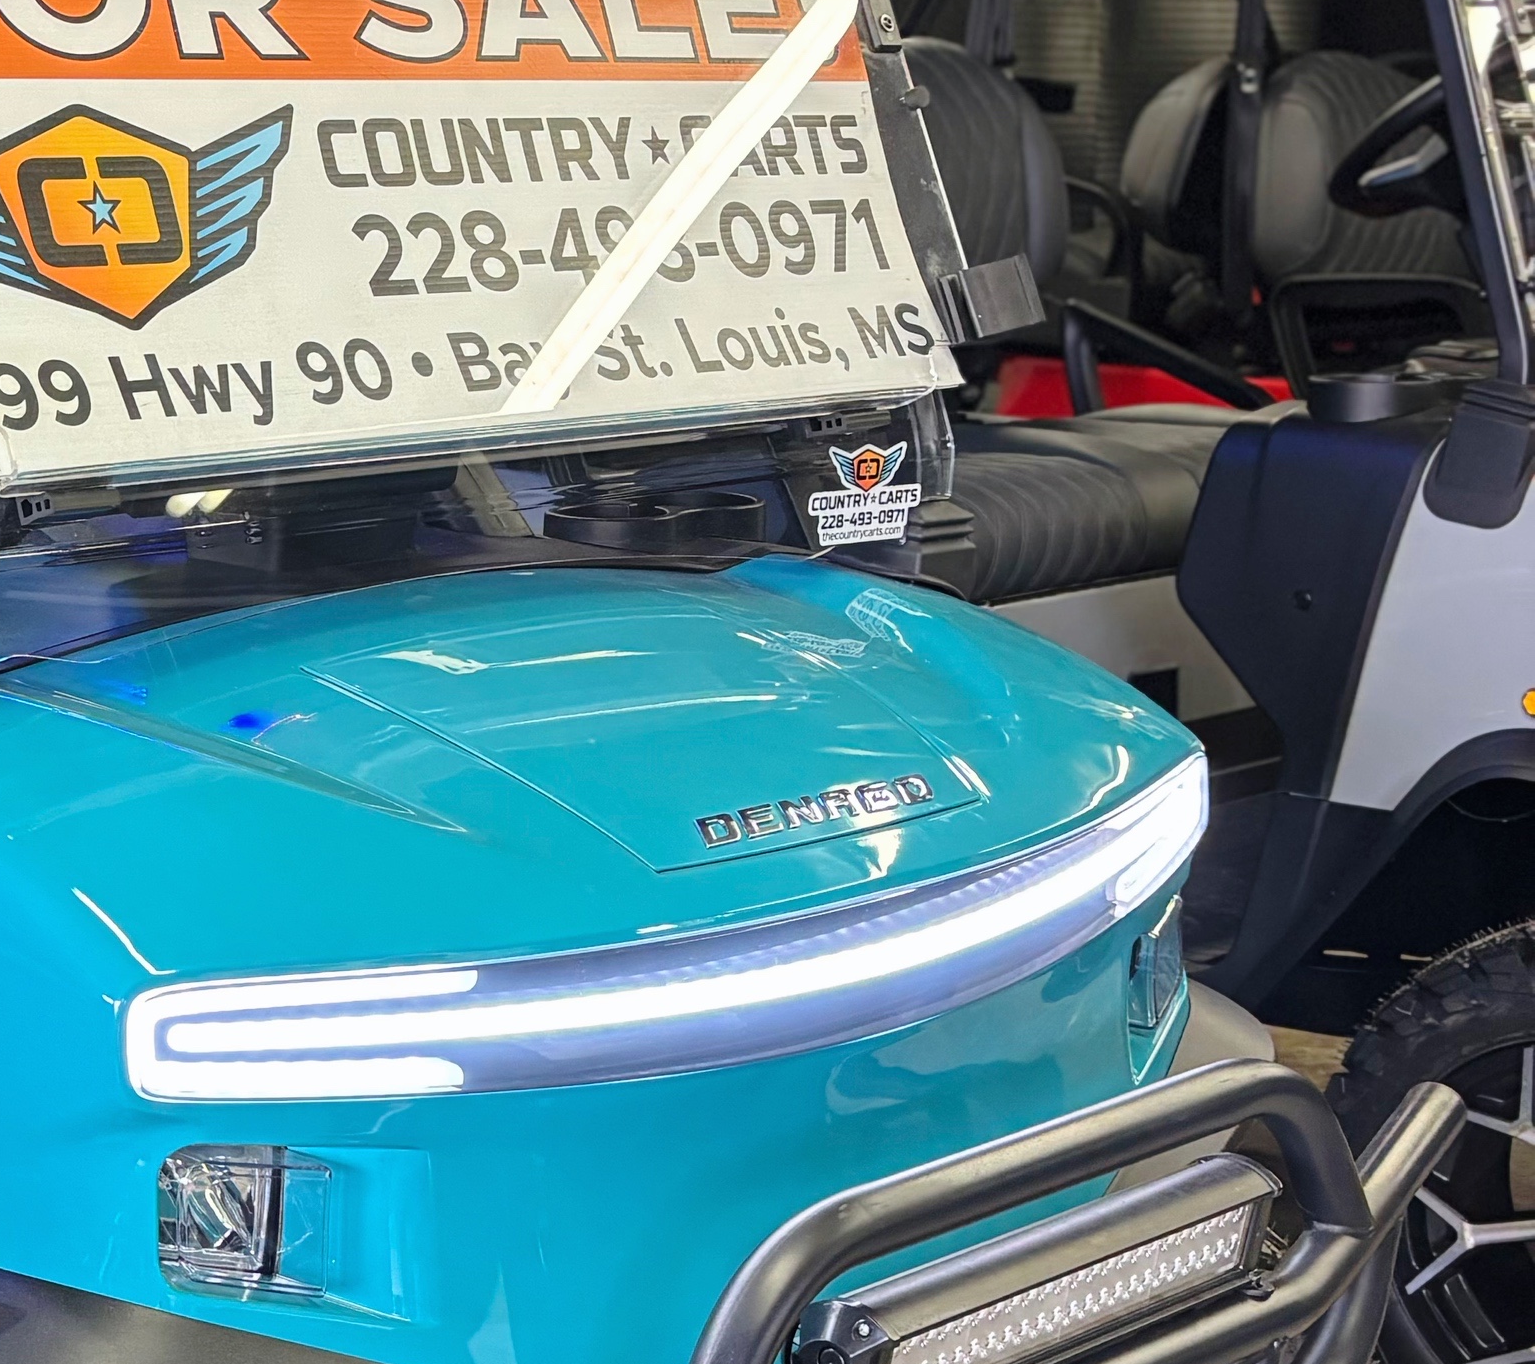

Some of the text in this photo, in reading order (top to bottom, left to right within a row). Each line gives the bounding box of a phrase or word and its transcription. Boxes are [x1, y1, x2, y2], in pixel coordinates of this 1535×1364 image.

[317, 116, 632, 188] COUNTRY
[108, 353, 273, 425] Hwy
[296, 338, 393, 405] 90
[446, 332, 570, 400] Ba
[674, 307, 850, 373] Louis,
[847, 303, 935, 359] MS
[811, 488, 918, 512] COUNTRY CARTS
[820, 508, 905, 530] 228-493-0971
[822, 526, 902, 542] thecountrycarts.com
